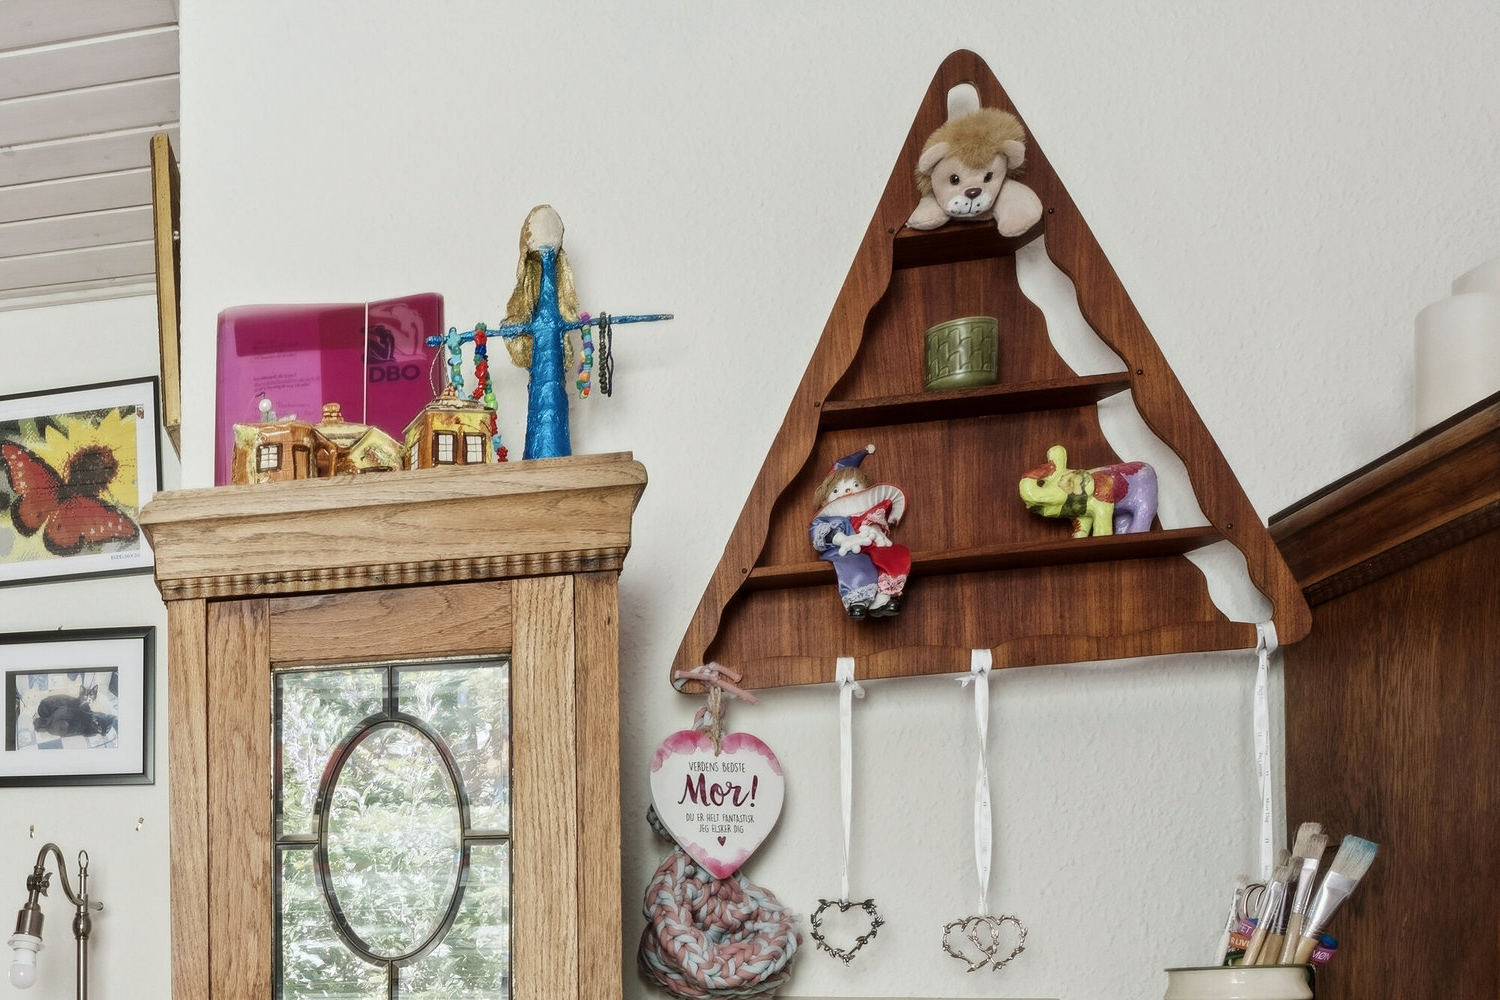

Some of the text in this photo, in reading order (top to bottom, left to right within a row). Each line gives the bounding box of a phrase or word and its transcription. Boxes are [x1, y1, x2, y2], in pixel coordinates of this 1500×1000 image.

[369, 363, 420, 383] DBO
[688, 761, 746, 773] VERDENS BEDSTE
[677, 772, 759, 808] Mor!
[686, 813, 755, 823] DU ER HELT FANTASTISK
[698, 824, 744, 834] JEG ELSKER DIG
